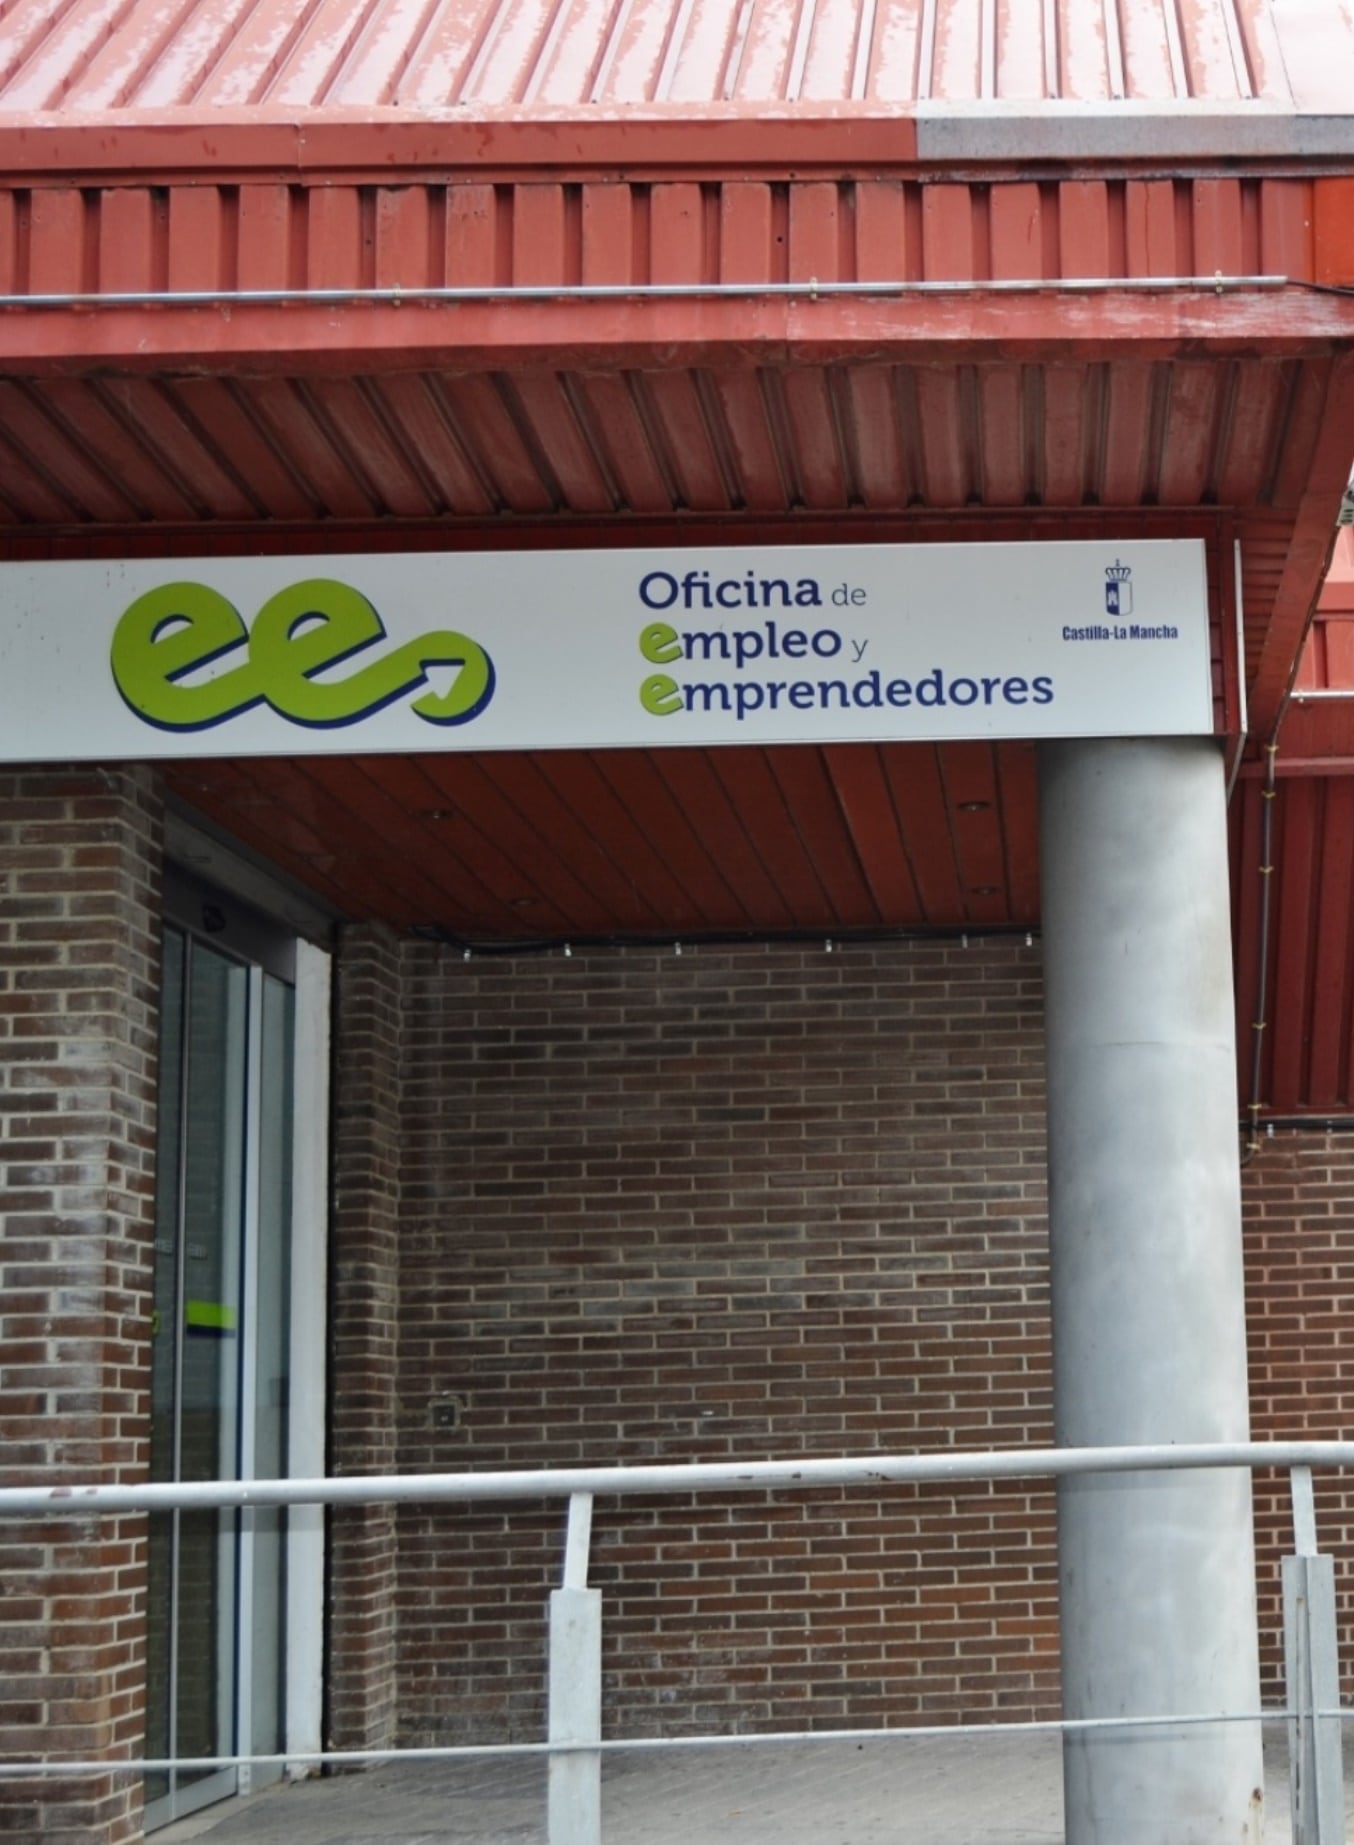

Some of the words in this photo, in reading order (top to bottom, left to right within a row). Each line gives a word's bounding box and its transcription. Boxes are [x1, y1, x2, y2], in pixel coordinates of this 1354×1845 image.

[639, 571, 822, 609] Oficina
[831, 584, 867, 606] de
[639, 621, 842, 667] empleo
[851, 635, 868, 662] y
[1062, 625, 1127, 640] Castilla-La
[1129, 624, 1178, 639] Mancha
[639, 669, 1054, 718] emprendedores
